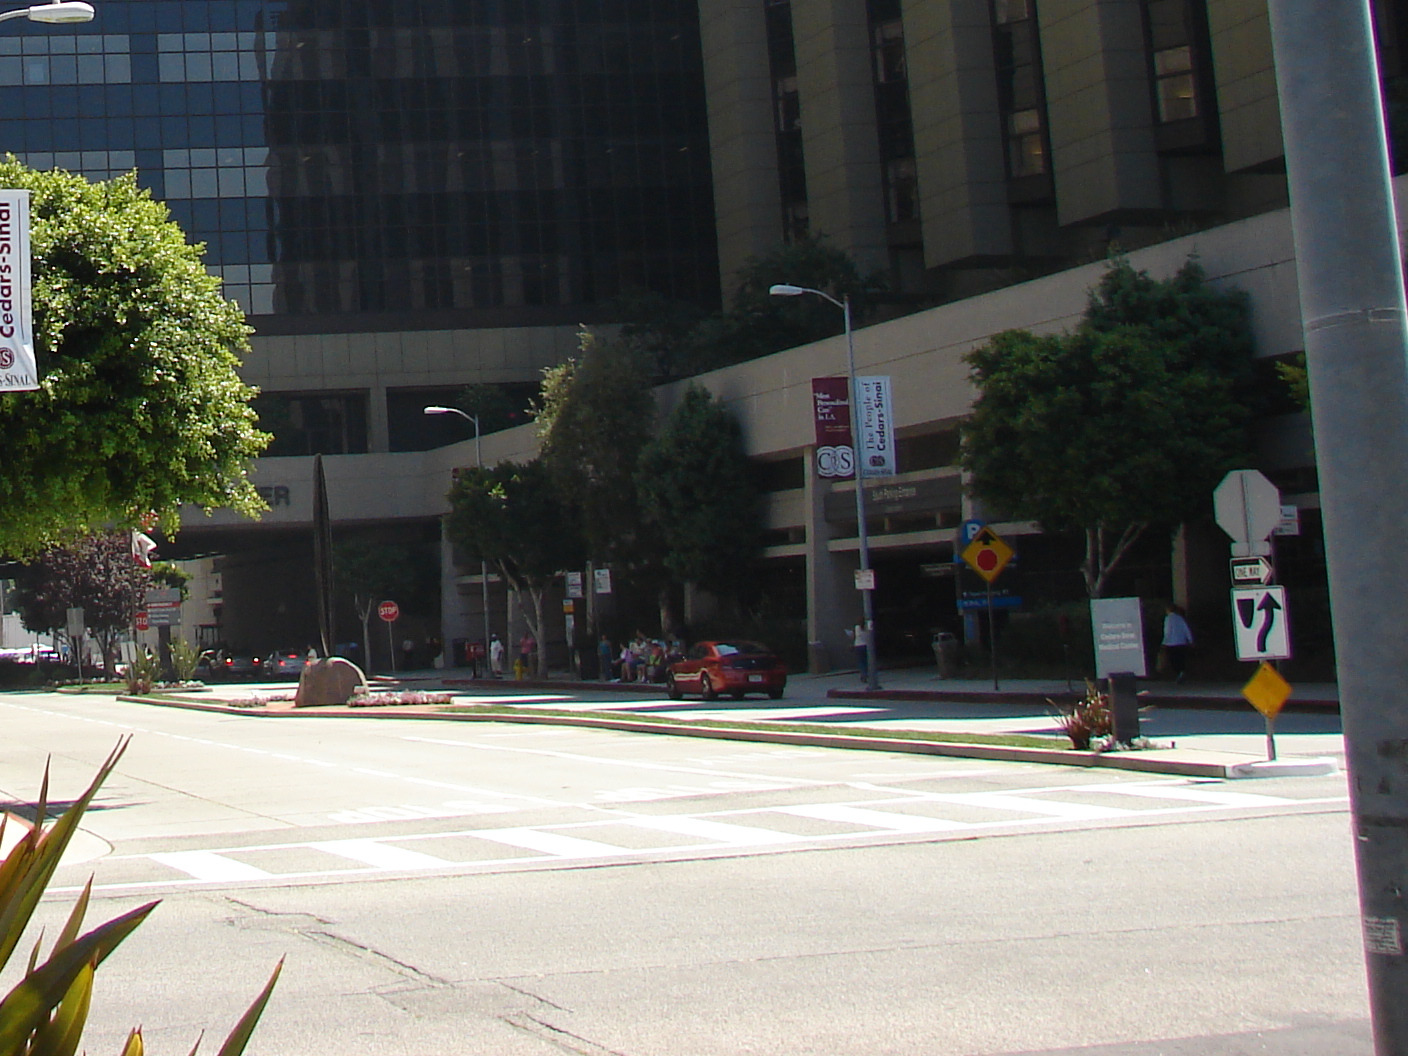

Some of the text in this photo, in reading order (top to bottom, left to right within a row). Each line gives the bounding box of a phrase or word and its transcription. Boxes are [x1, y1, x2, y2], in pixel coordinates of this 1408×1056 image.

[873, 381, 885, 451] Cedars-Sinai
[380, 606, 397, 615] STOP
[135, 617, 148, 625] STO
